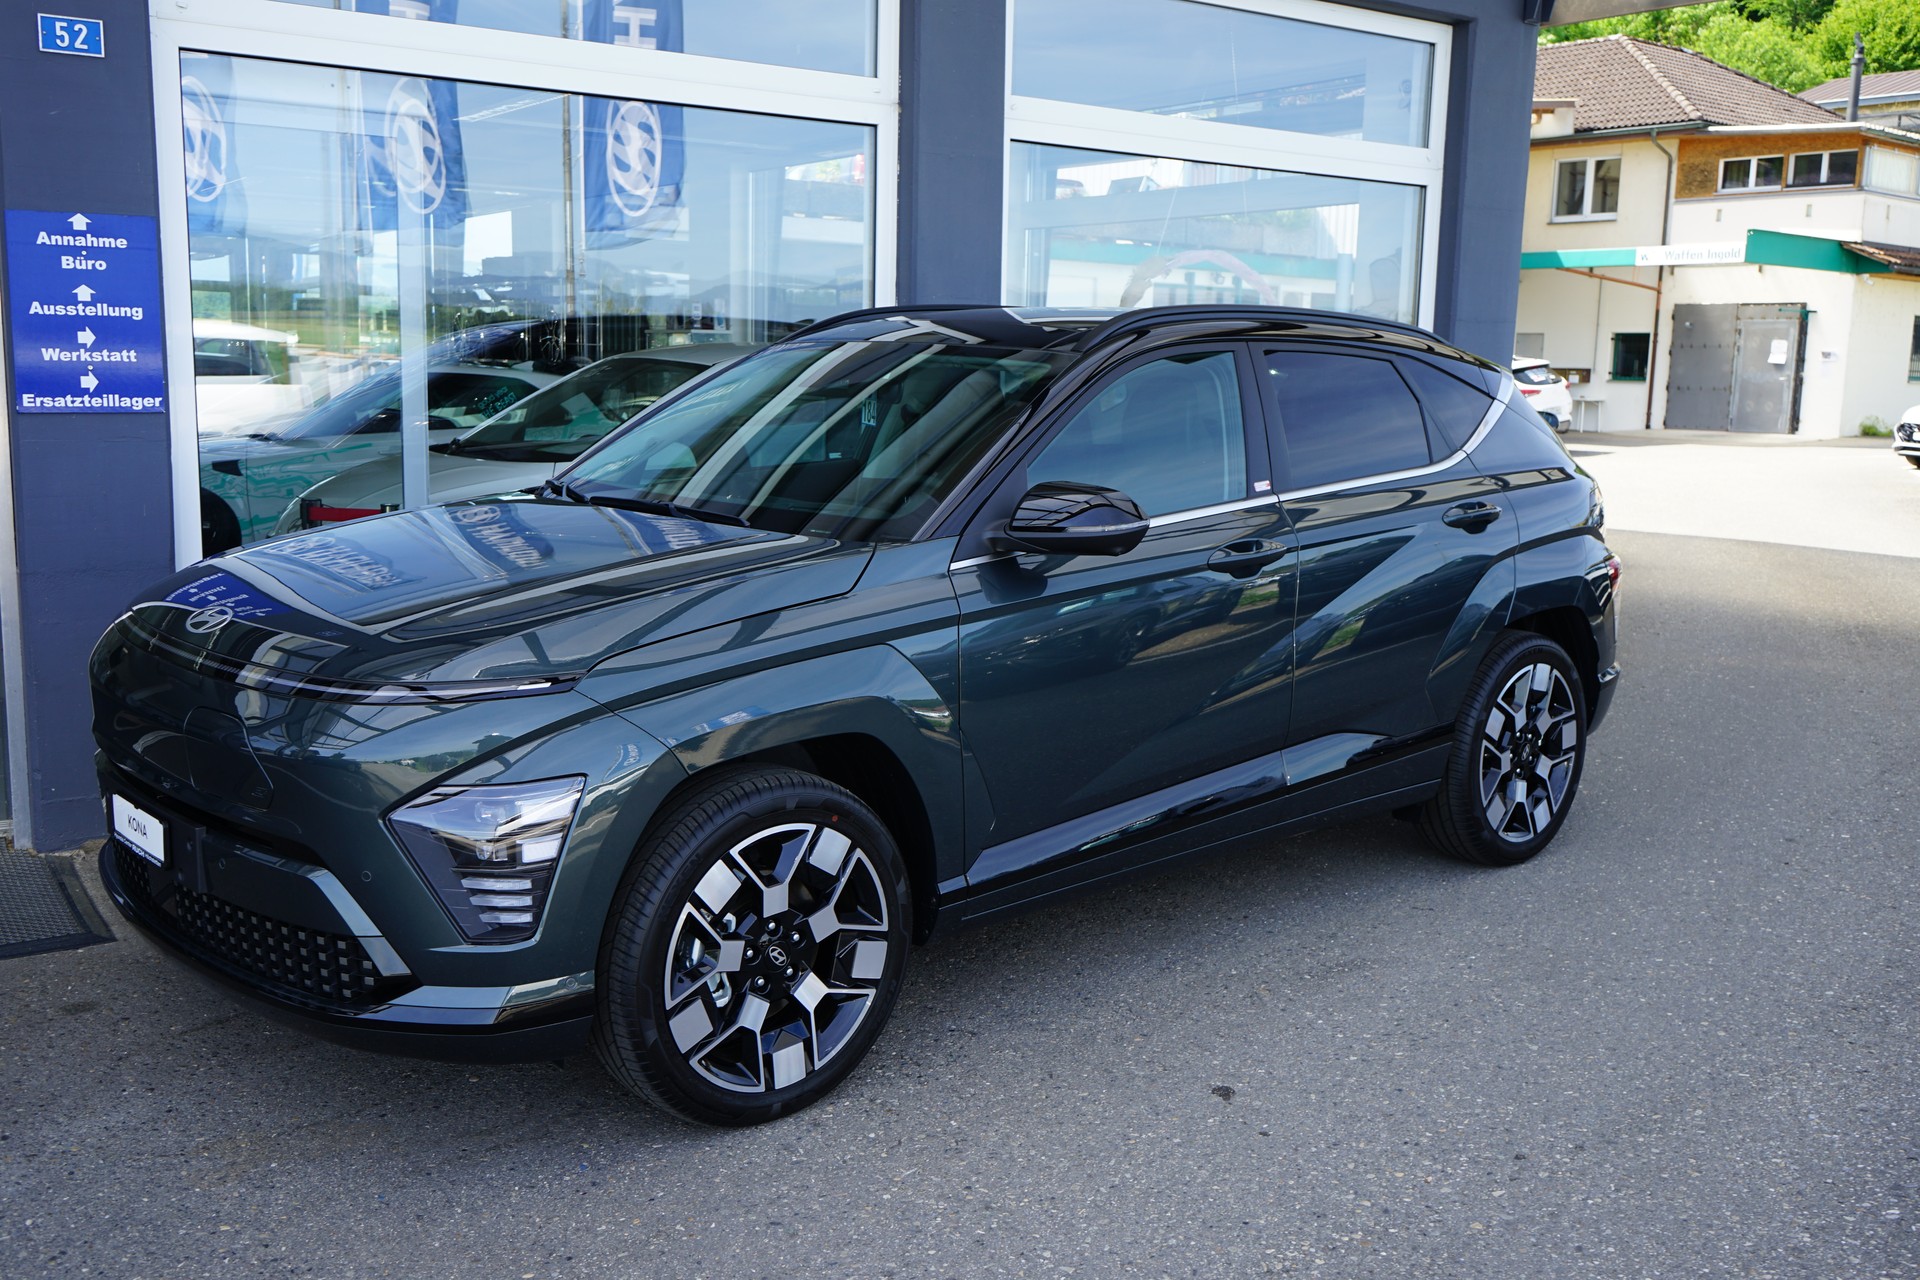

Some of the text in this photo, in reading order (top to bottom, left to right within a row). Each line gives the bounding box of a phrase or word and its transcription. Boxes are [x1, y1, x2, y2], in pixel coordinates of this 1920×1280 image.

[54, 20, 90, 51] 52
[36, 231, 127, 248] Annahme
[61, 254, 107, 271] Büro
[1664, 249, 1703, 261] Waffen
[1707, 247, 1741, 261] Ingold
[29, 301, 144, 321] Ausstellung
[41, 347, 137, 363] Werkstatt
[22, 393, 164, 411] Ersatzteillager
[862, 400, 875, 423] 184
[128, 814, 148, 839] KONA
